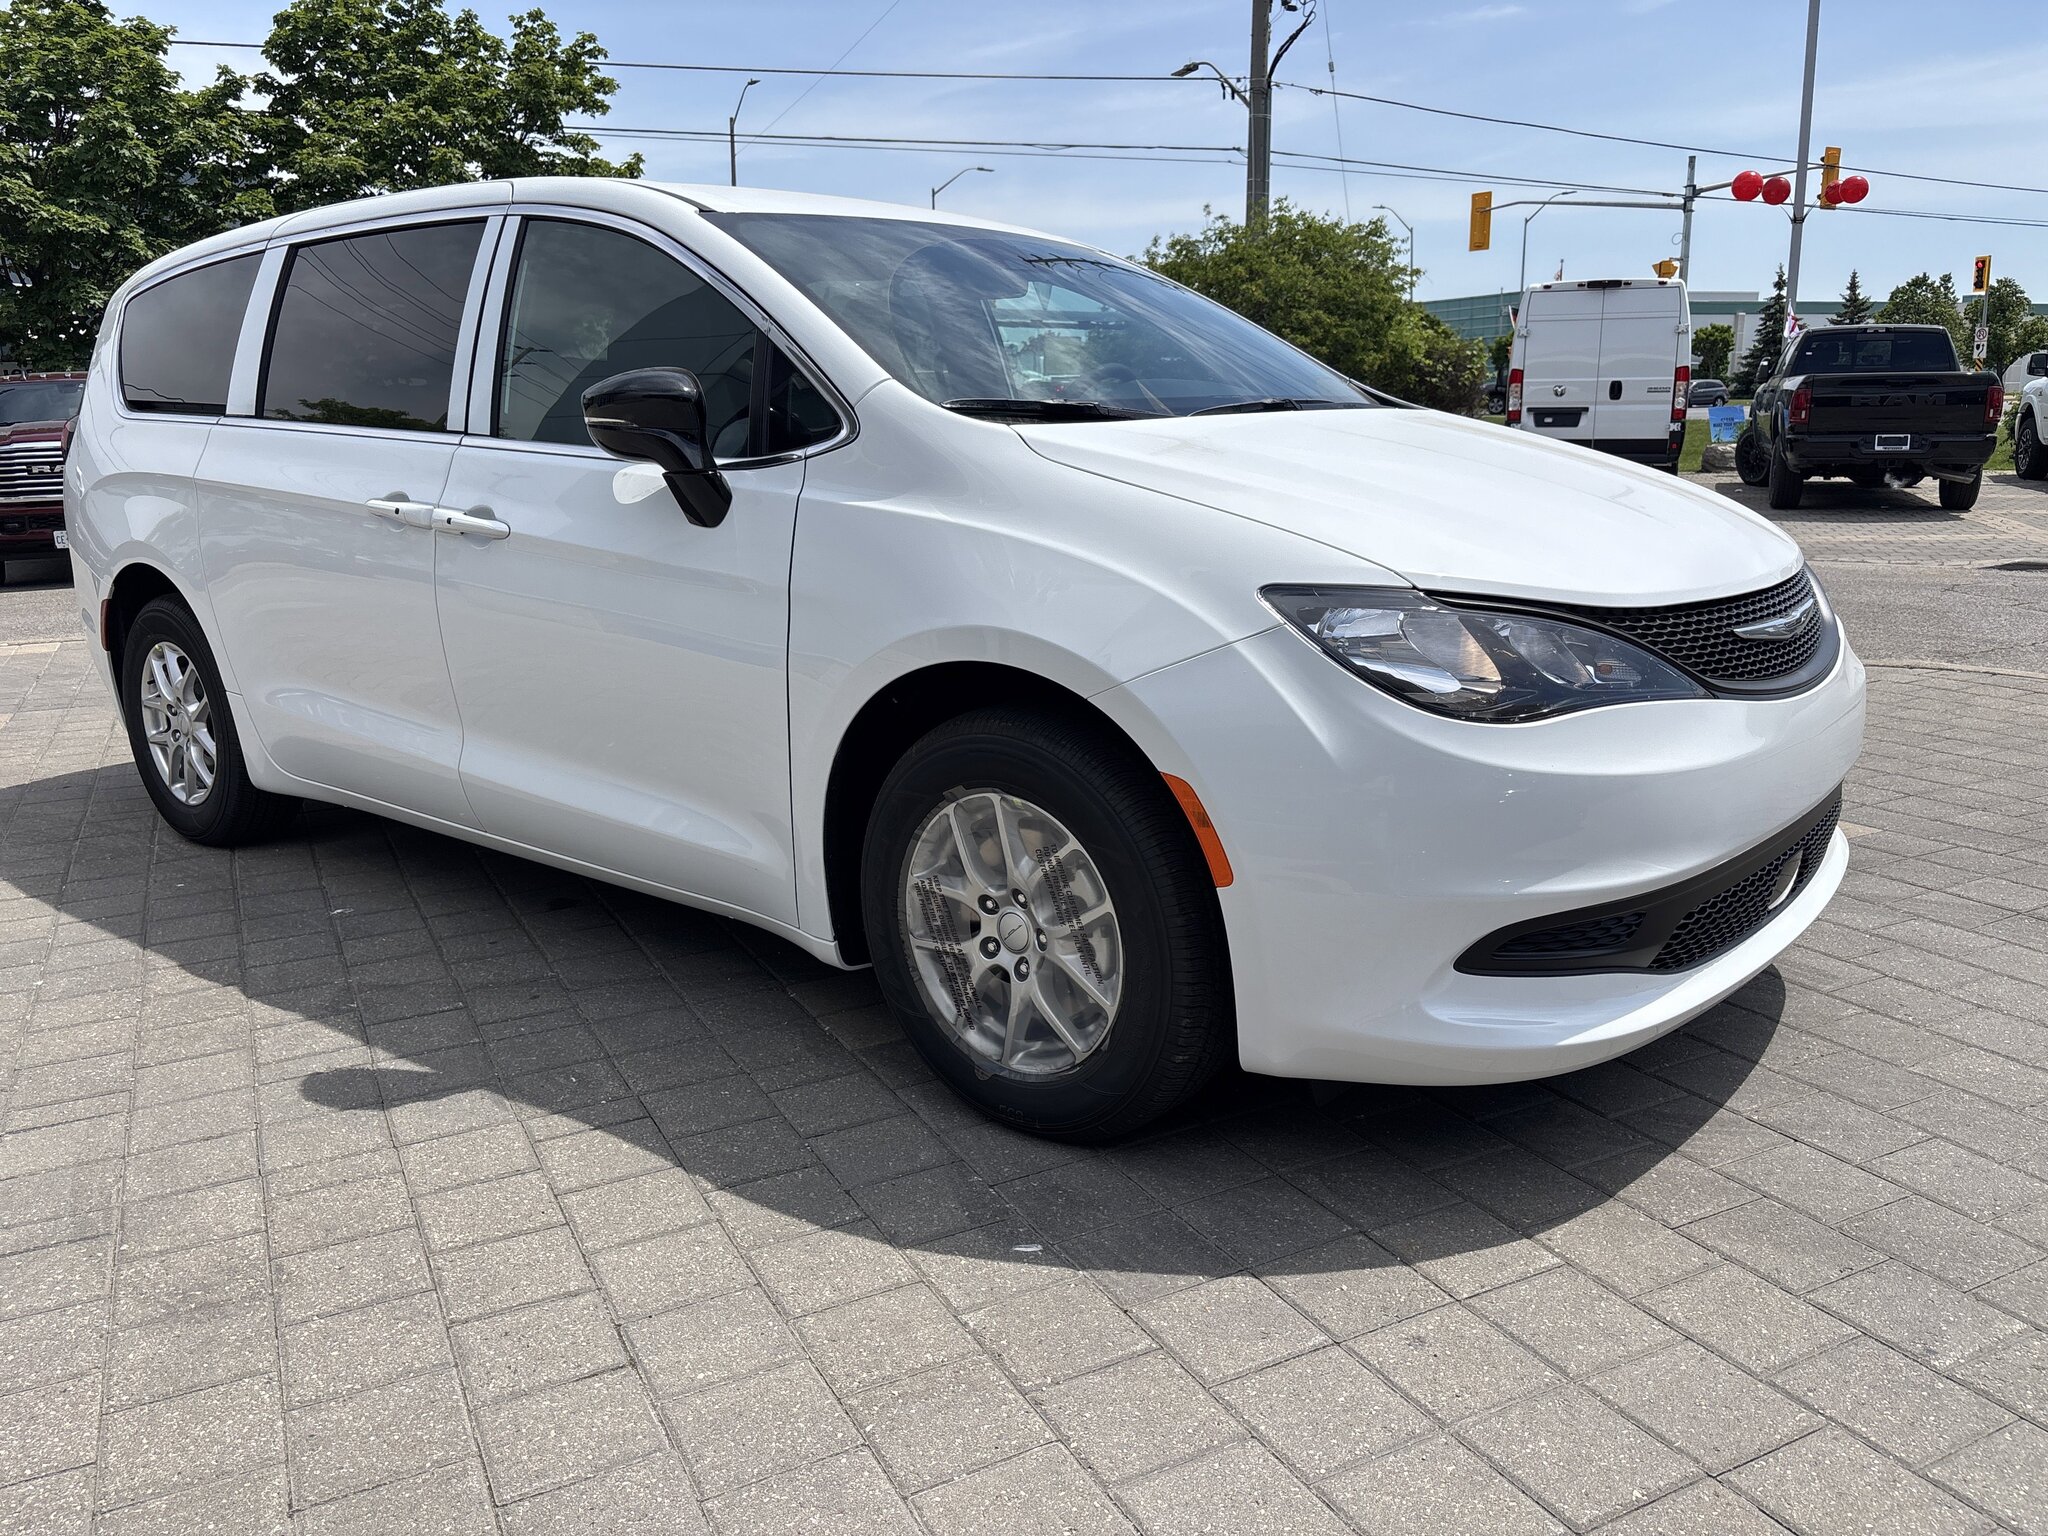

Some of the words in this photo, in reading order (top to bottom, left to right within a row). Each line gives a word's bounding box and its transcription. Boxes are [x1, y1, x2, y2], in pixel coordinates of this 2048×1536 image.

[1851, 393, 1946, 406] RAM
[1035, 848, 1054, 889] CUSTOMER
[920, 880, 932, 906] ADJUST
[926, 878, 942, 914] PRESSURE
[932, 874, 942, 893] KEEP
[944, 908, 962, 948] PRESSURE
[1054, 855, 1070, 889] IMPROVE
[1066, 890, 1084, 931] CUSTOMER
[1047, 859, 1056, 874] NOT
[1052, 876, 1067, 906] REMOVE
[1064, 907, 1077, 933] WHEEL
[1079, 954, 1092, 976] UNTIL
